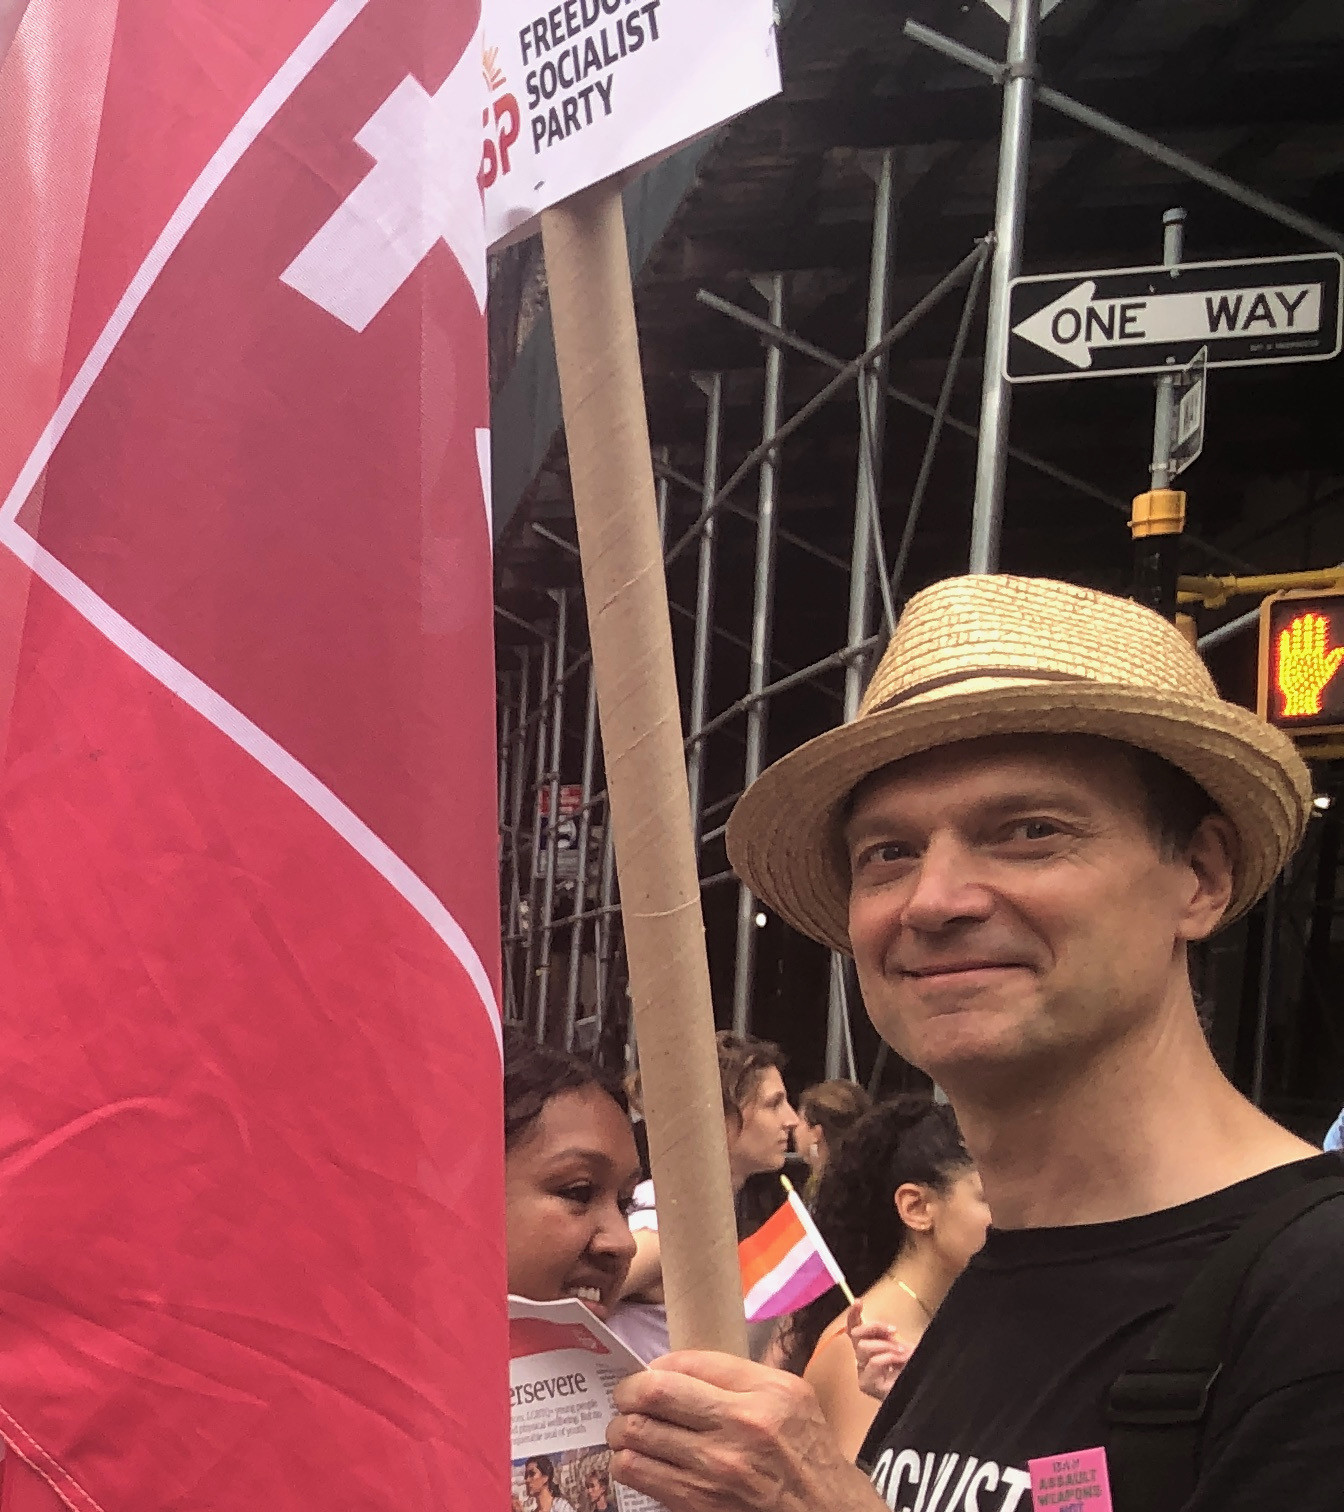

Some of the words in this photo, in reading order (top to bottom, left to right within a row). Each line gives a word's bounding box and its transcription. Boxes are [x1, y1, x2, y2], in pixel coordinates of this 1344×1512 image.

[519, 0, 632, 66] FREED
[525, 0, 661, 111] SOCIALIST
[531, 73, 614, 155] PARTY
[1051, 301, 1147, 345] ONE
[1205, 289, 1310, 334] WAY
[1039, 1469, 1097, 1491] ASSAULT
